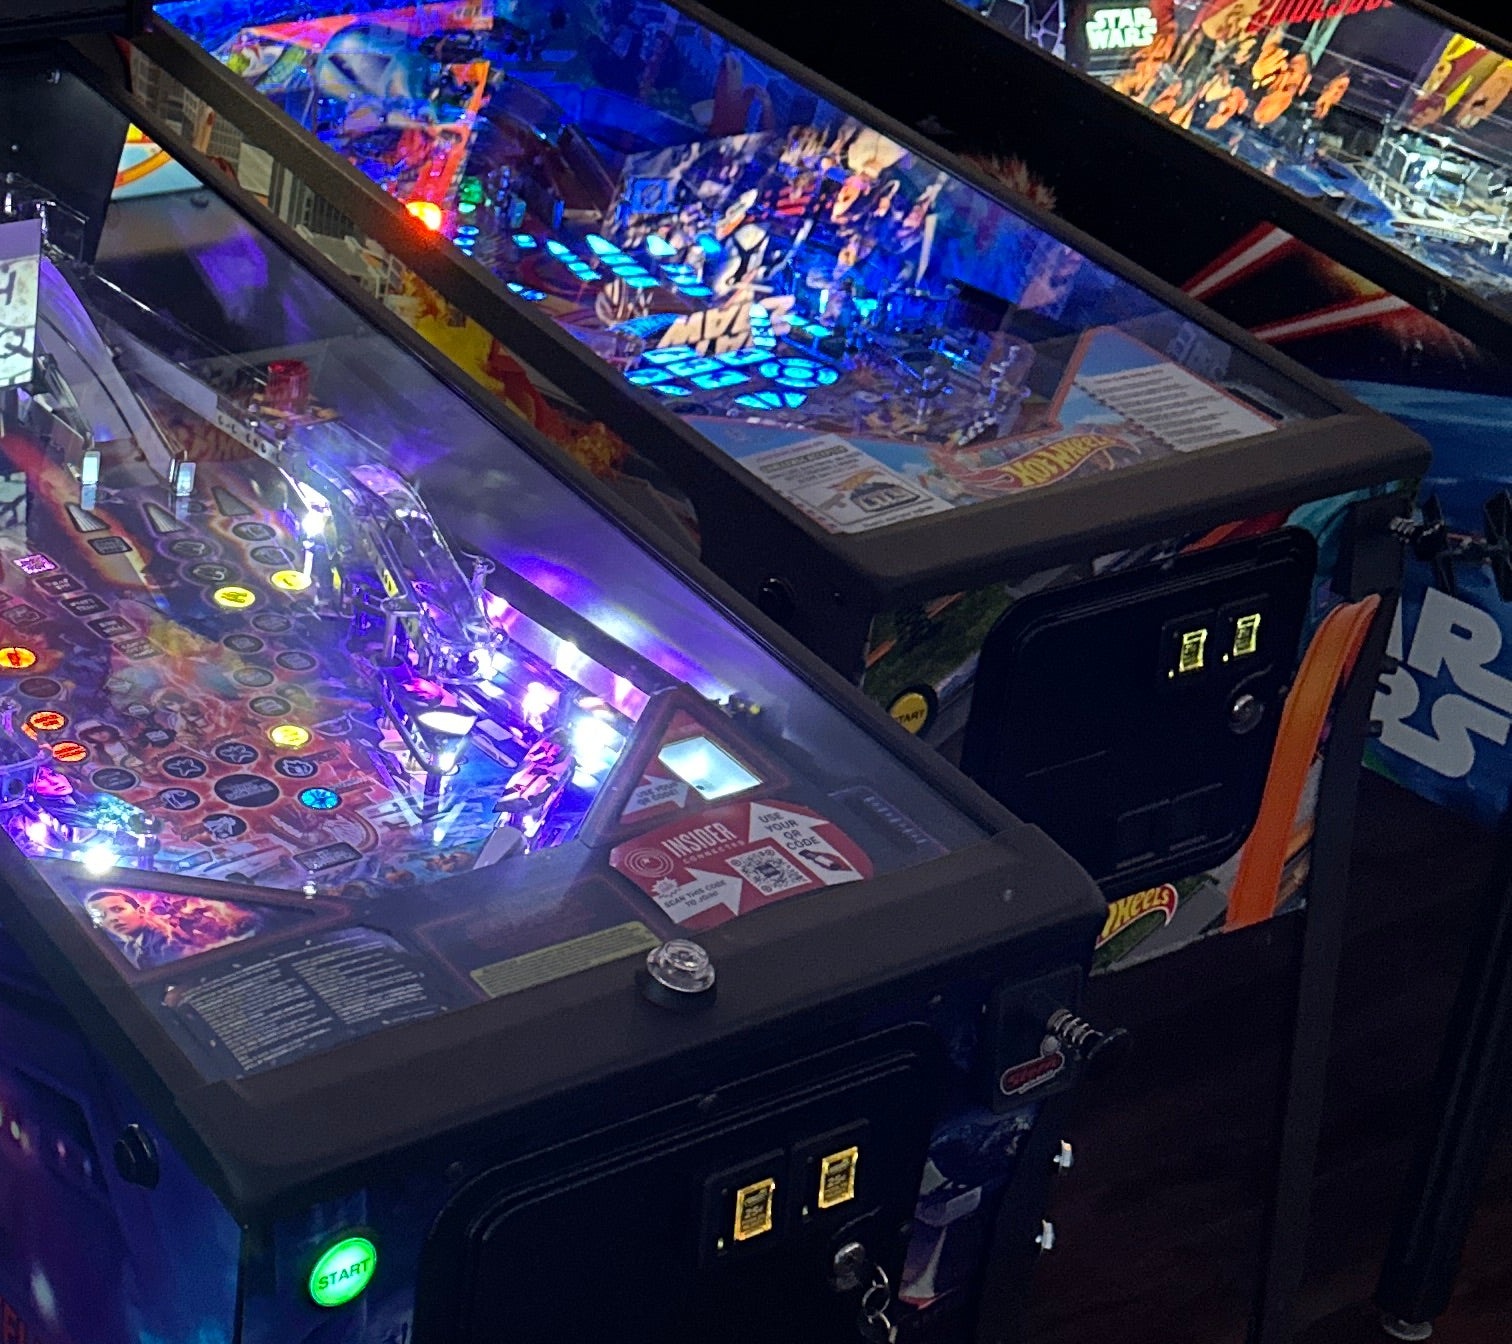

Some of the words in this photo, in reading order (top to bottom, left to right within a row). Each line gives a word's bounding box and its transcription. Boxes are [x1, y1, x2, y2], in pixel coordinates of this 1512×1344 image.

[1090, 6, 1158, 30] STAR
[1086, 24, 1157, 50] WARS
[758, 811, 784, 824] USE
[764, 819, 794, 833] YOUR
[661, 822, 737, 858] INSIDER
[786, 836, 821, 850] CODE
[664, 896, 686, 908] SCAN
[687, 888, 705, 899] THIS
[705, 879, 727, 892] CODE
[685, 898, 697, 908] TO
[318, 1258, 372, 1292] START
